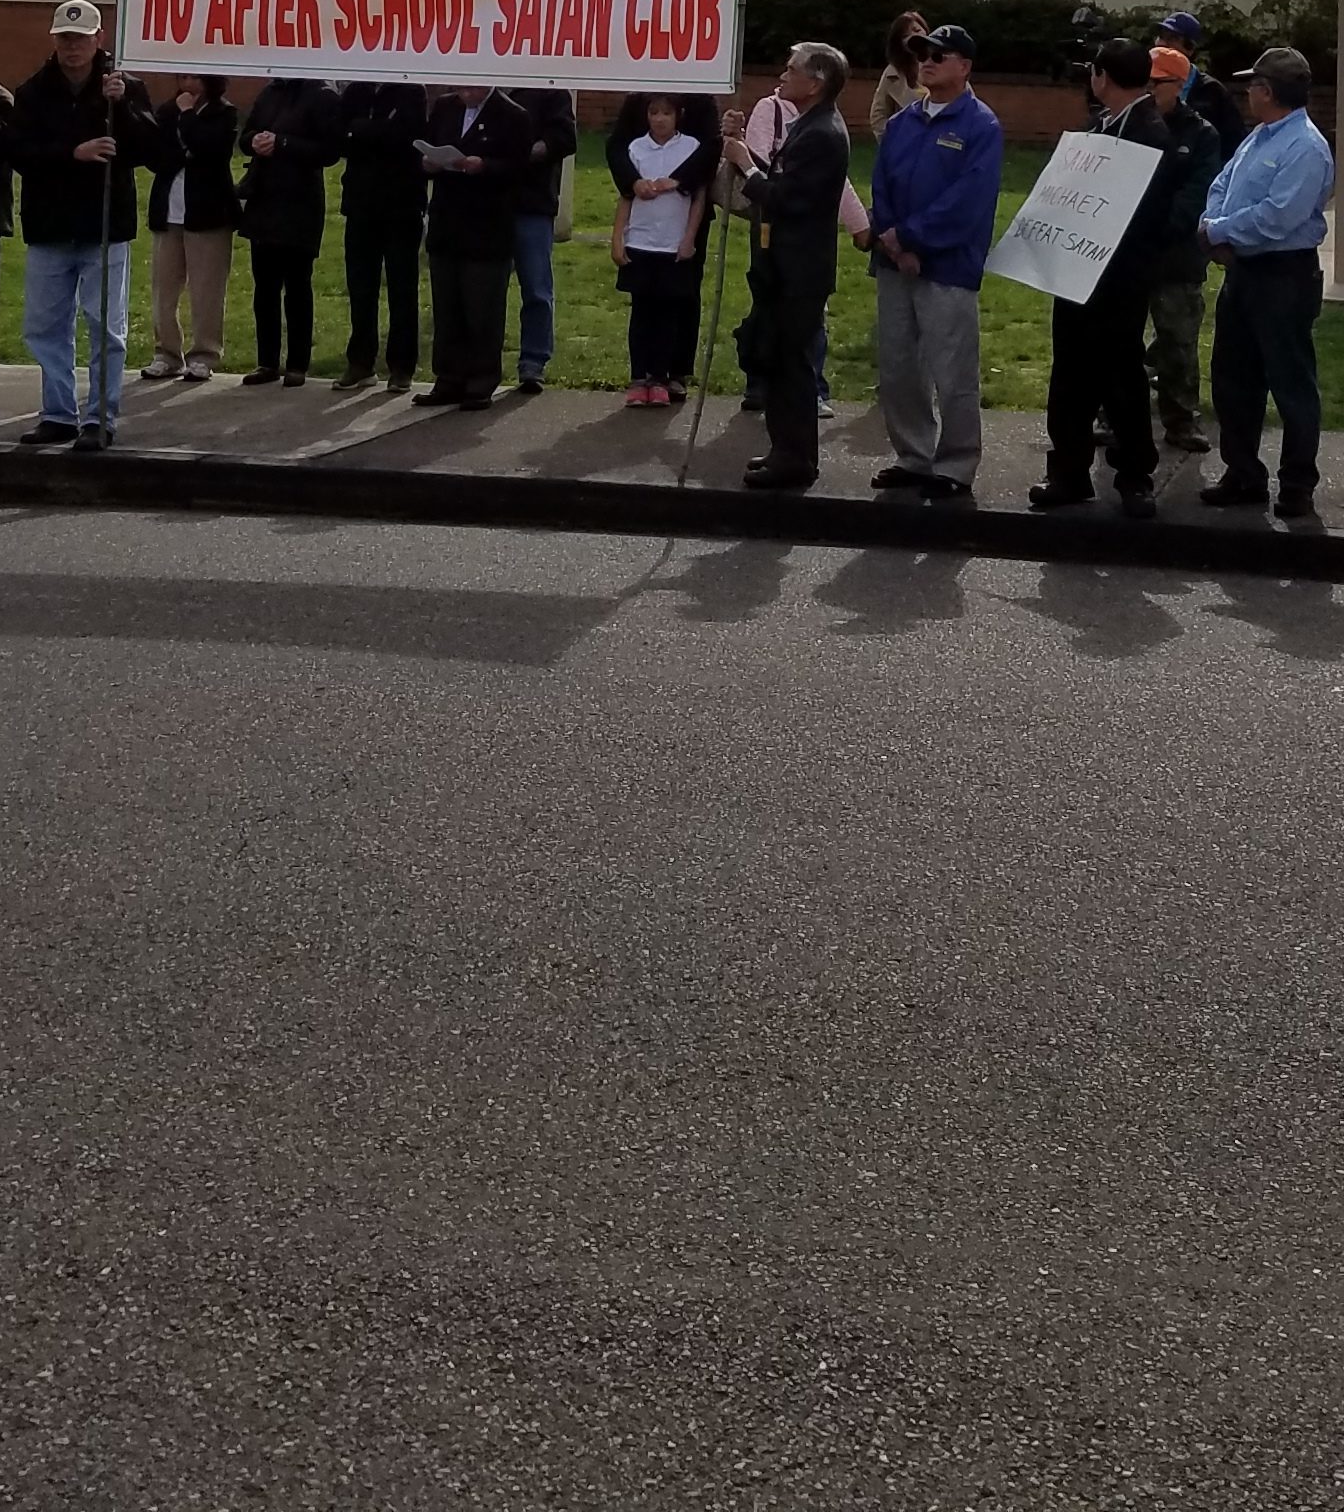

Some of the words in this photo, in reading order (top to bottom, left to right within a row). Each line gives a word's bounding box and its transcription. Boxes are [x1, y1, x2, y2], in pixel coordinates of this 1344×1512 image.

[1064, 147, 1111, 174] SAINT
[1014, 216, 1064, 246] DEFEAT
[1061, 231, 1112, 262] SATAN
